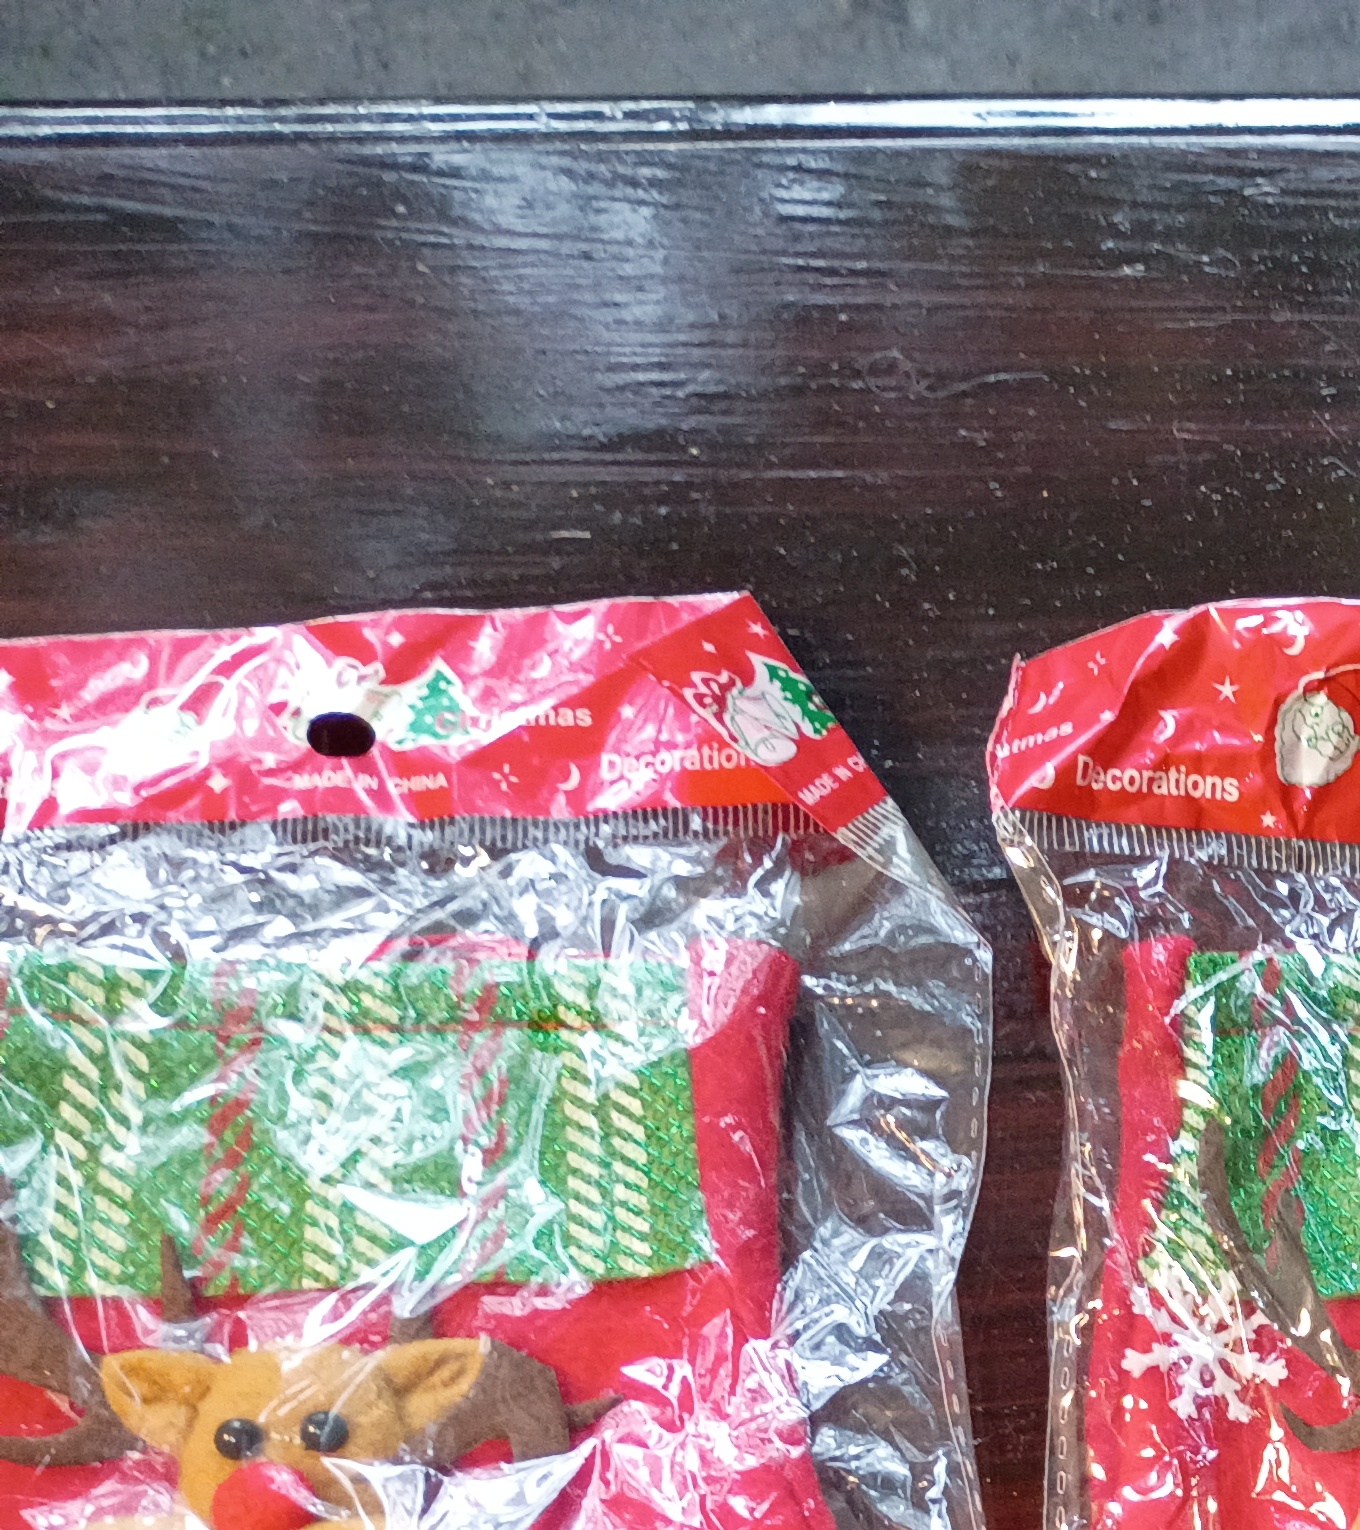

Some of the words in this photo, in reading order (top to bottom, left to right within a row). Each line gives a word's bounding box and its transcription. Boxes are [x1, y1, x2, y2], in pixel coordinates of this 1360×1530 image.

[391, 771, 449, 795] CHINA
[600, 744, 756, 781] Decoration
[797, 771, 839, 807] MADE
[832, 760, 854, 783] IN
[1075, 753, 1241, 803] Decorations
